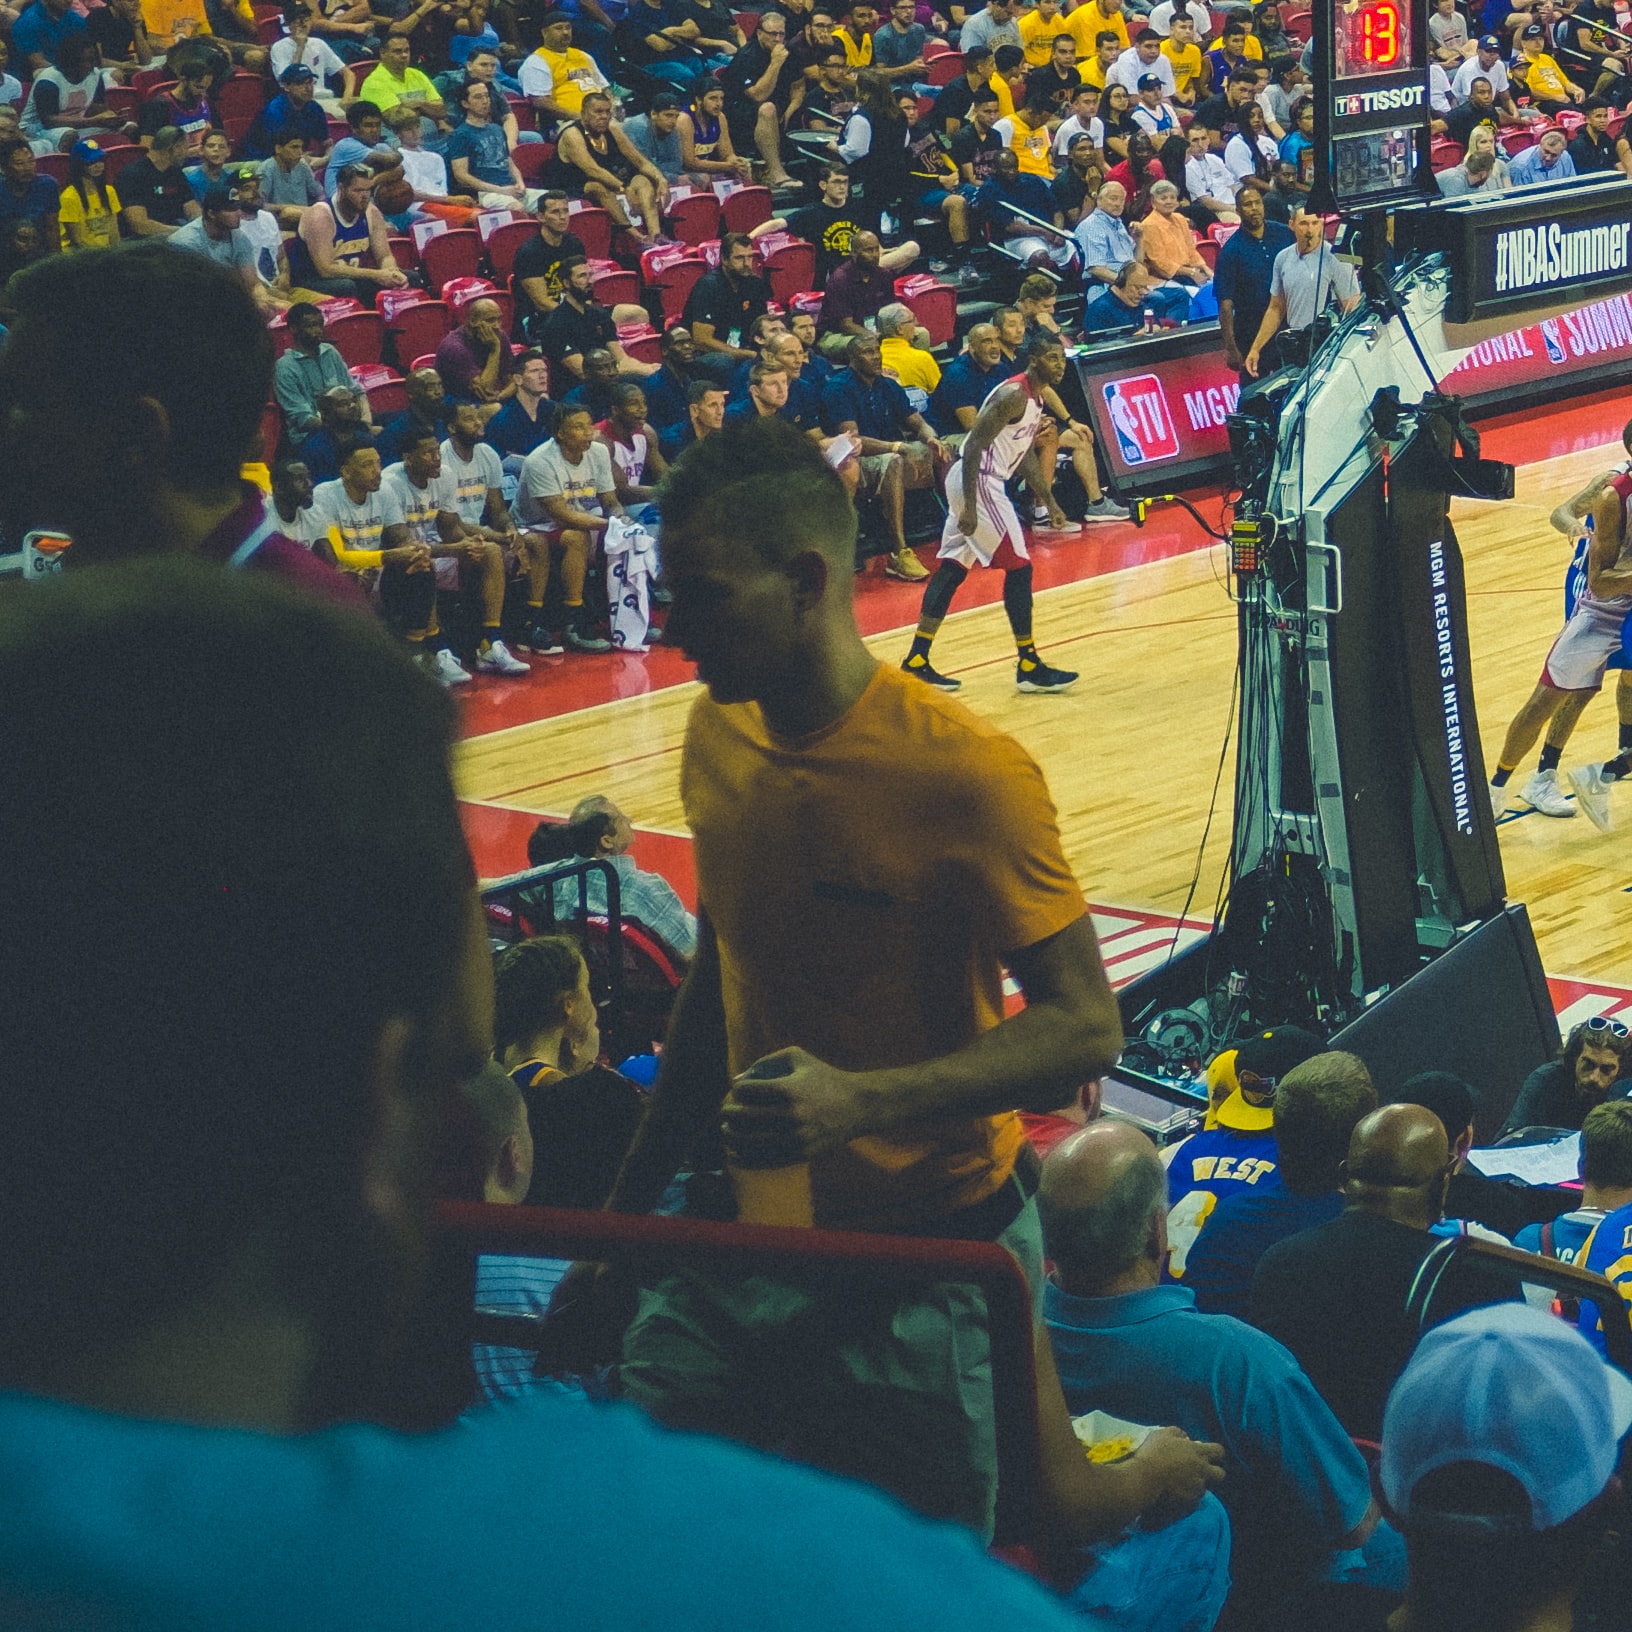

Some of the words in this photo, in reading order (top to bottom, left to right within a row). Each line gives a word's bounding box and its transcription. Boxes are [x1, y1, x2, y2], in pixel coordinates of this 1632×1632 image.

[1363, 4, 1398, 65] 13
[1362, 85, 1425, 111] TISSOT
[1496, 221, 1631, 292] #NBASummer
[1130, 390, 1165, 443] TV
[1429, 541, 1447, 587] MGM
[1434, 591, 1456, 679] RESORTS
[1192, 1155, 1275, 1186] WEST
